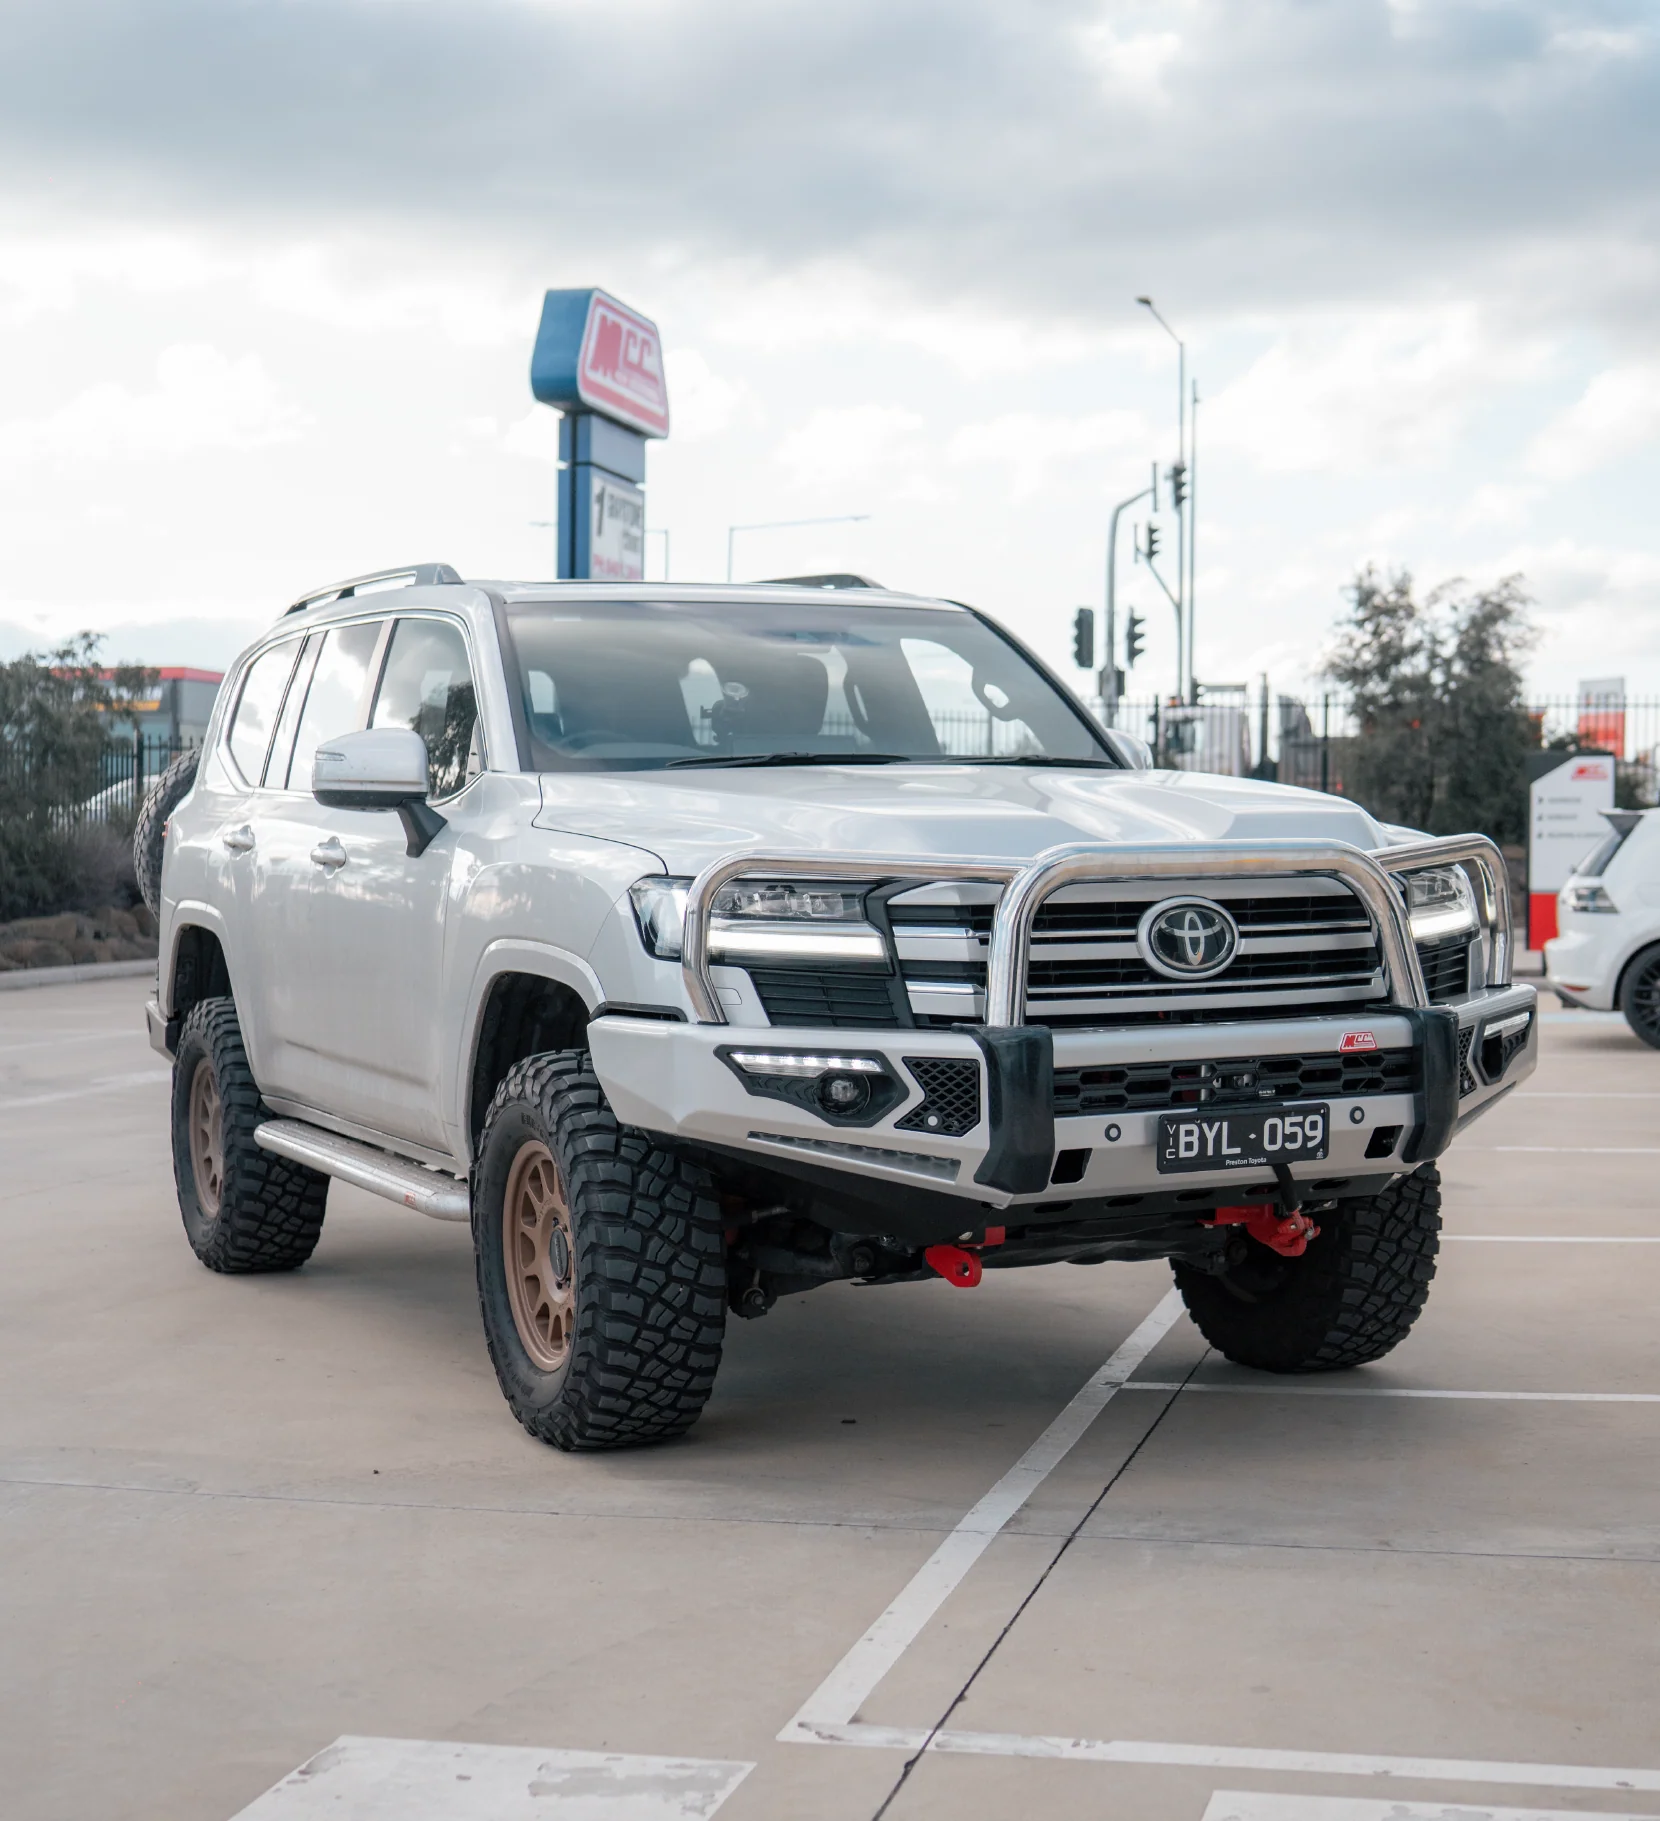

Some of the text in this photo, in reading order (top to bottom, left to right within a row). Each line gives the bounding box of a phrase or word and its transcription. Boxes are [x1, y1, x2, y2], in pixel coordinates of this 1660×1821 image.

[1166, 1124, 1177, 1159] VIC
[1178, 1114, 1324, 1159] BYL 059
[1248, 1157, 1267, 1165] Toyota
